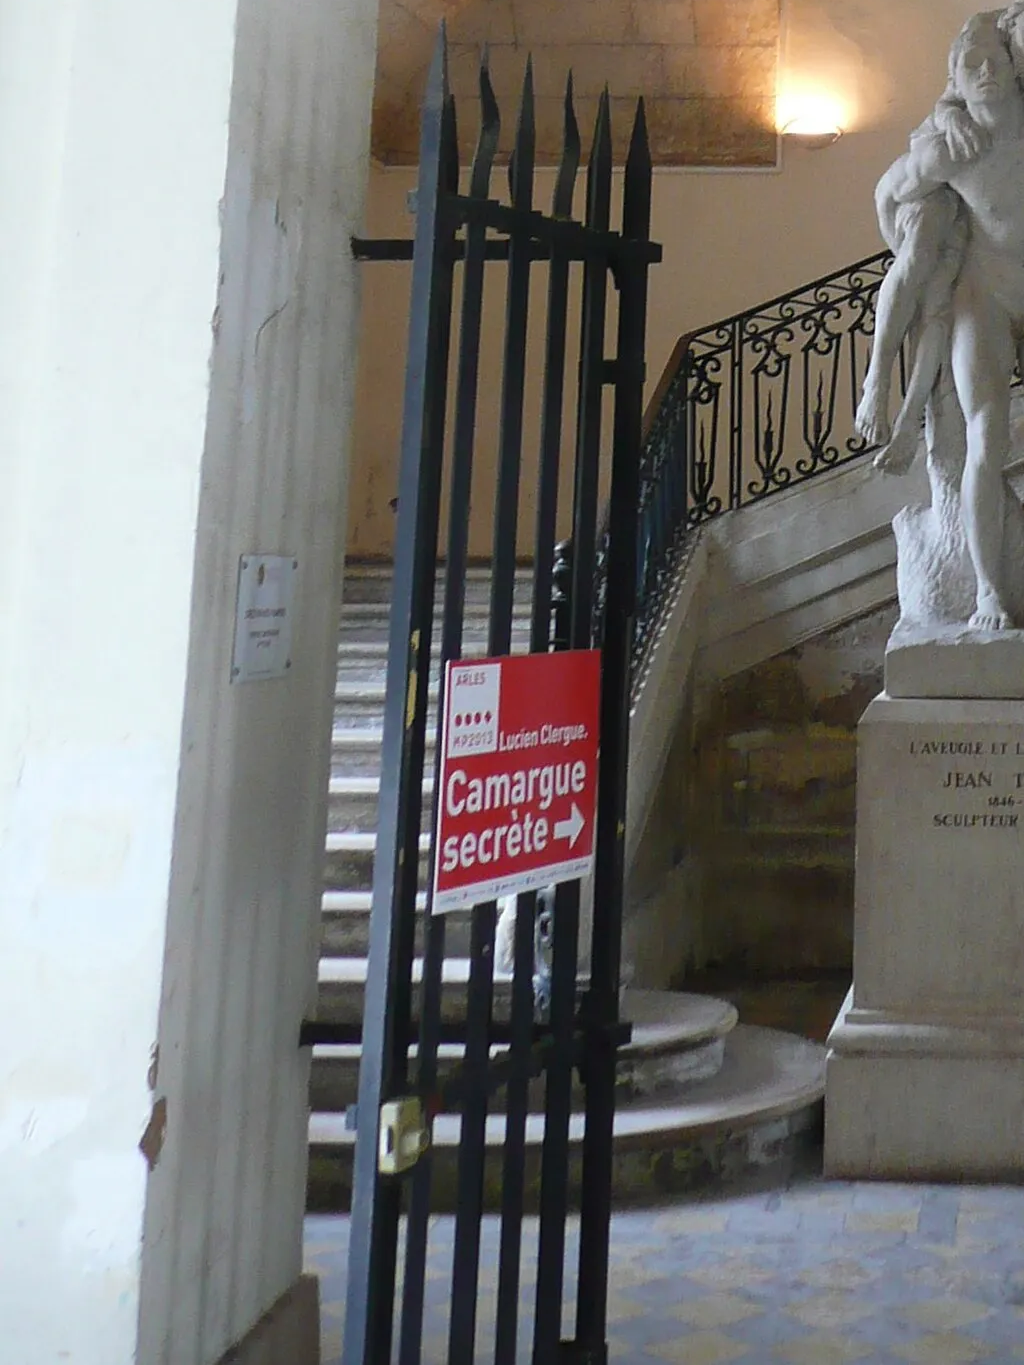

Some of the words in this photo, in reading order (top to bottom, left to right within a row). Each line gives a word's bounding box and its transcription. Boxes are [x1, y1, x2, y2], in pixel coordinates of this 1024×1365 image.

[455, 672, 486, 687] ARLES
[499, 730, 538, 752] Lucien
[540, 723, 588, 747] Clergue.
[910, 742, 983, 755] L'AVEUGLE
[991, 742, 1008, 755] ET
[446, 759, 587, 817] Camargue
[943, 772, 992, 789] JEAN
[932, 814, 1019, 828] SCULPTEUR
[442, 808, 549, 872] secrète
